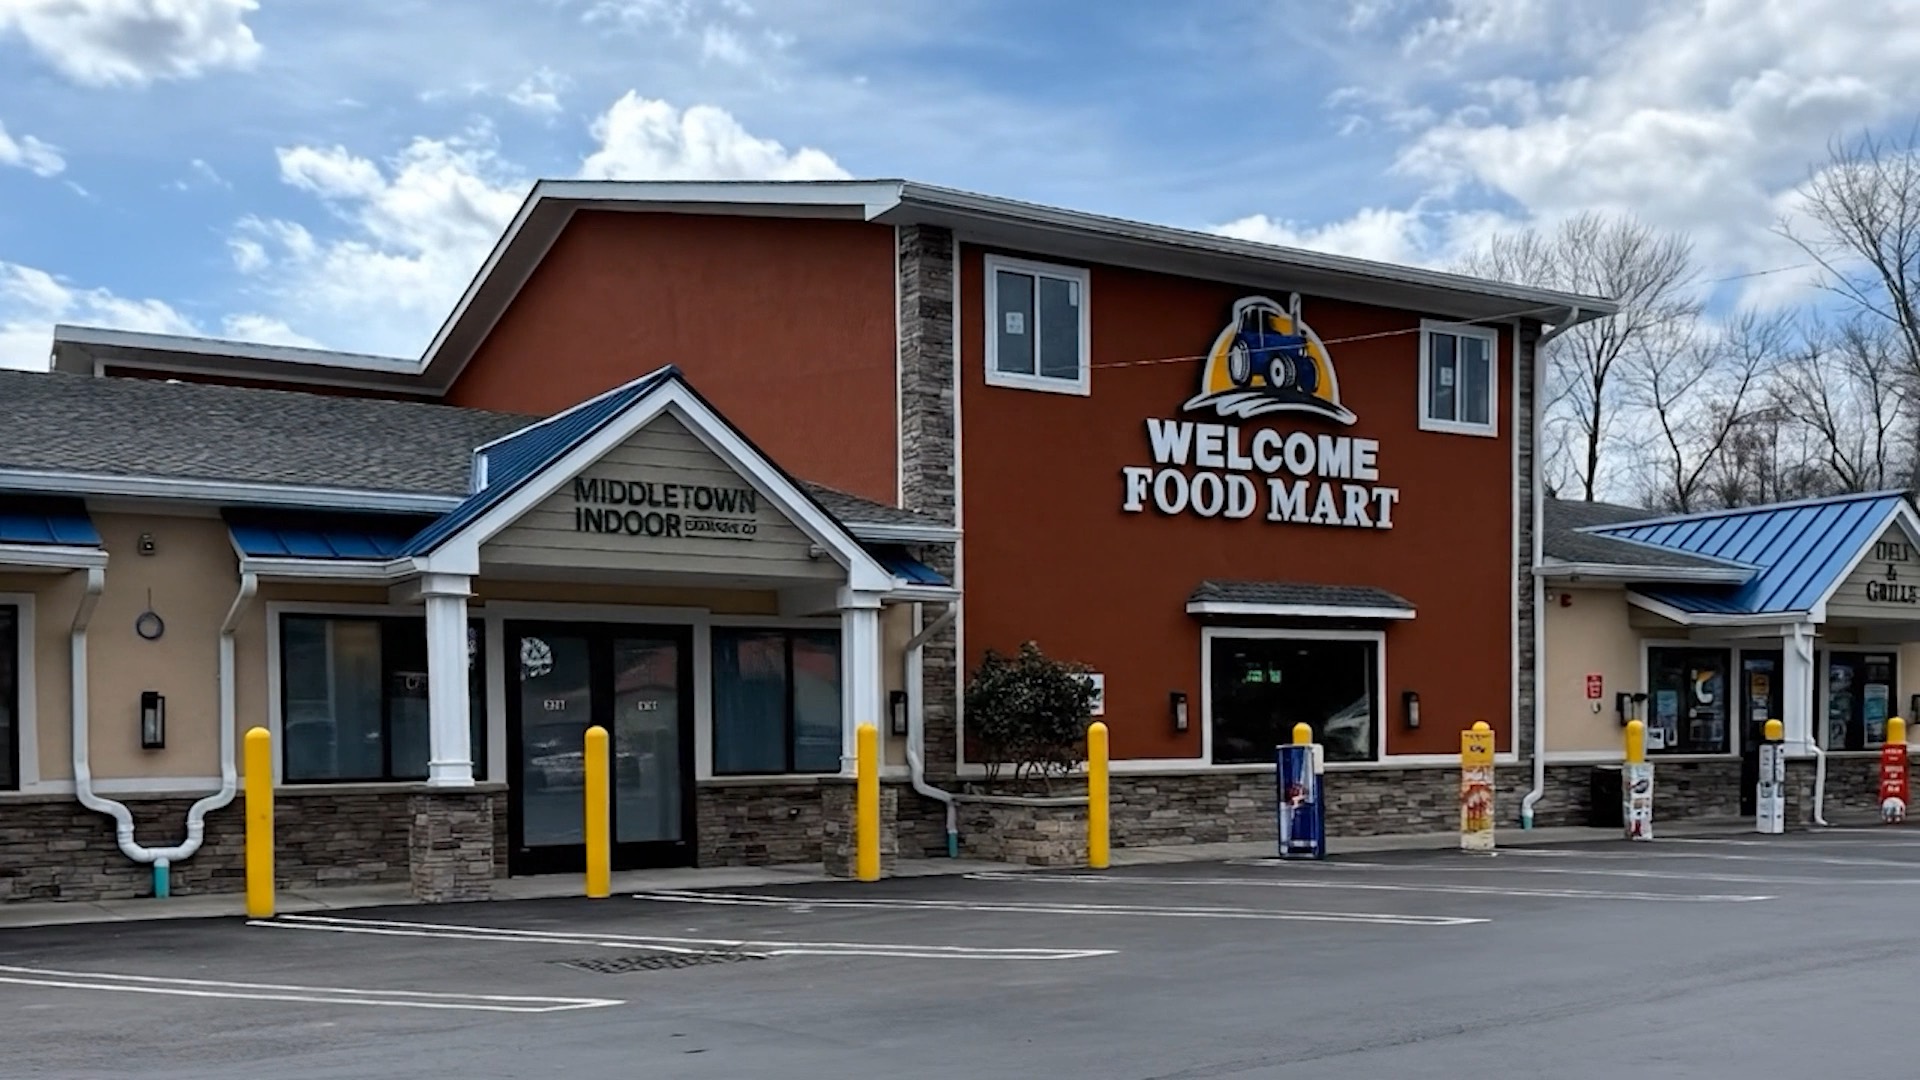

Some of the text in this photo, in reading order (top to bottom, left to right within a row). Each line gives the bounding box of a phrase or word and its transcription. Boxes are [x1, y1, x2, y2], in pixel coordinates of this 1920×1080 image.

[1147, 418, 1379, 481] WELCOME
[573, 477, 757, 513] MIDDLETOWN
[1123, 466, 1399, 529] FOOD MART
[574, 507, 682, 537] INDOOR
